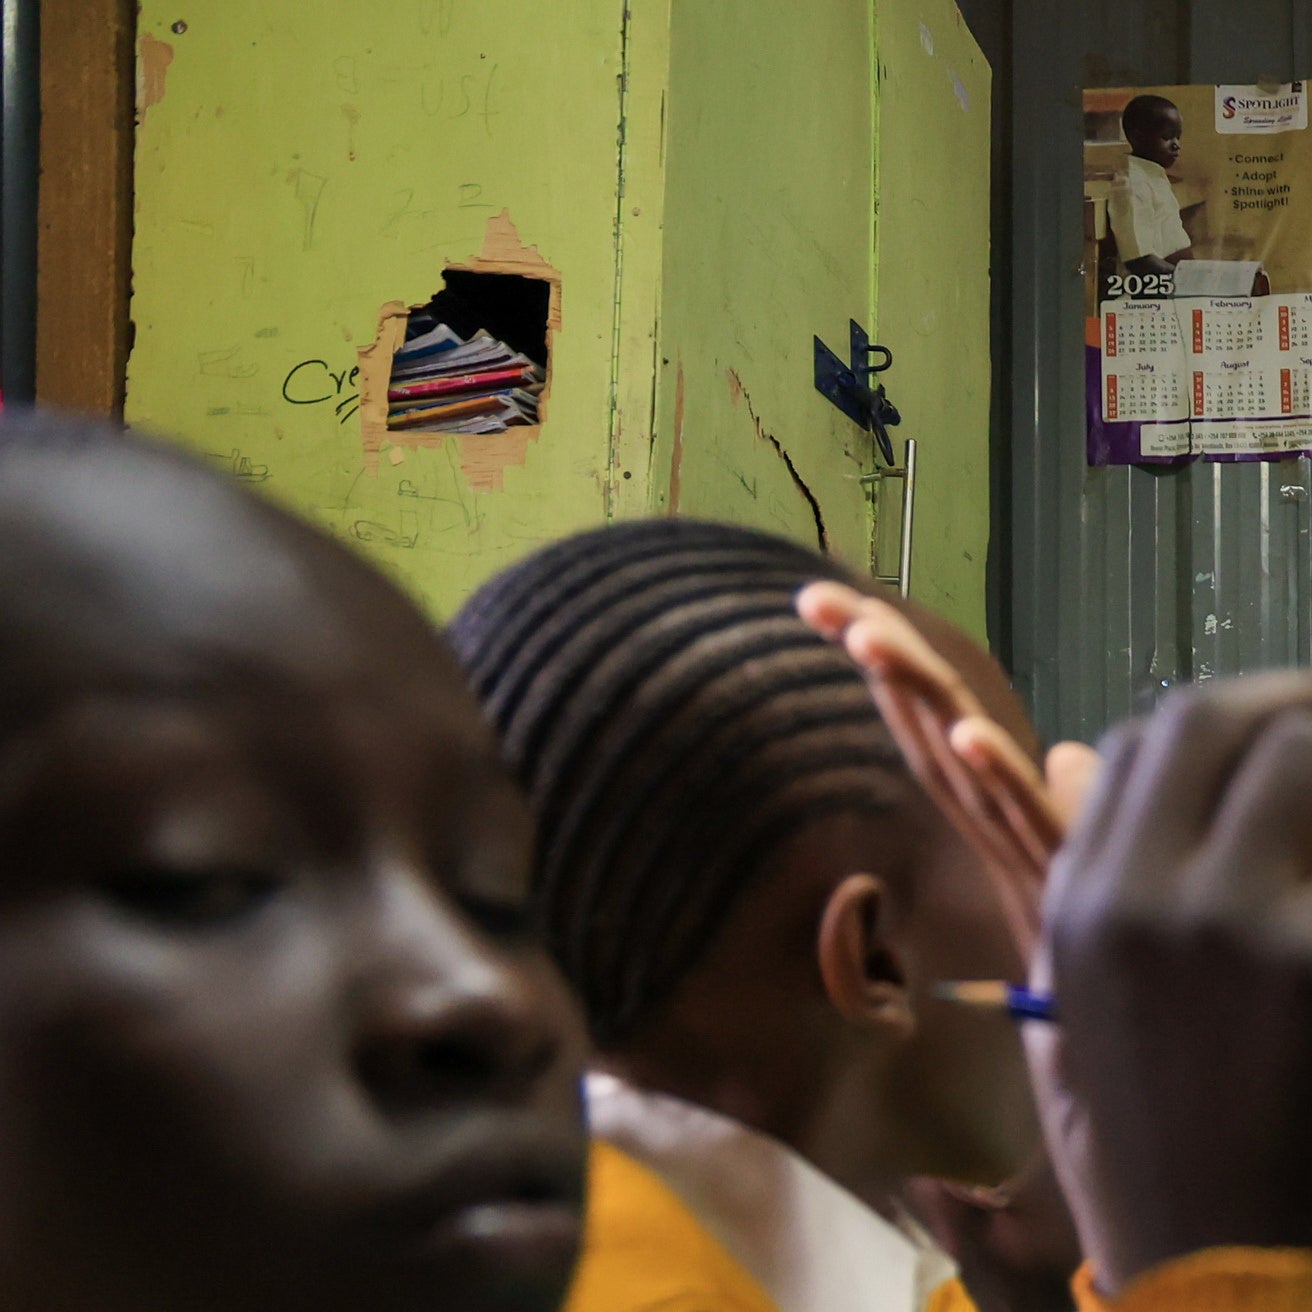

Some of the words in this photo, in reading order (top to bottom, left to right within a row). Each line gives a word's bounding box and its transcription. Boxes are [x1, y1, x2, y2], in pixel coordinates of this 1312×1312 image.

[1235, 153, 1284, 164] Connect
[1242, 171, 1277, 183] Adopt
[1231, 187, 1264, 196] Shine
[1266, 185, 1291, 195] with
[1107, 274, 1175, 296] 2025
[1122, 302, 1160, 310] January
[1210, 300, 1252, 309] February
[1136, 363, 1154, 372] July
[1221, 361, 1250, 370] August
